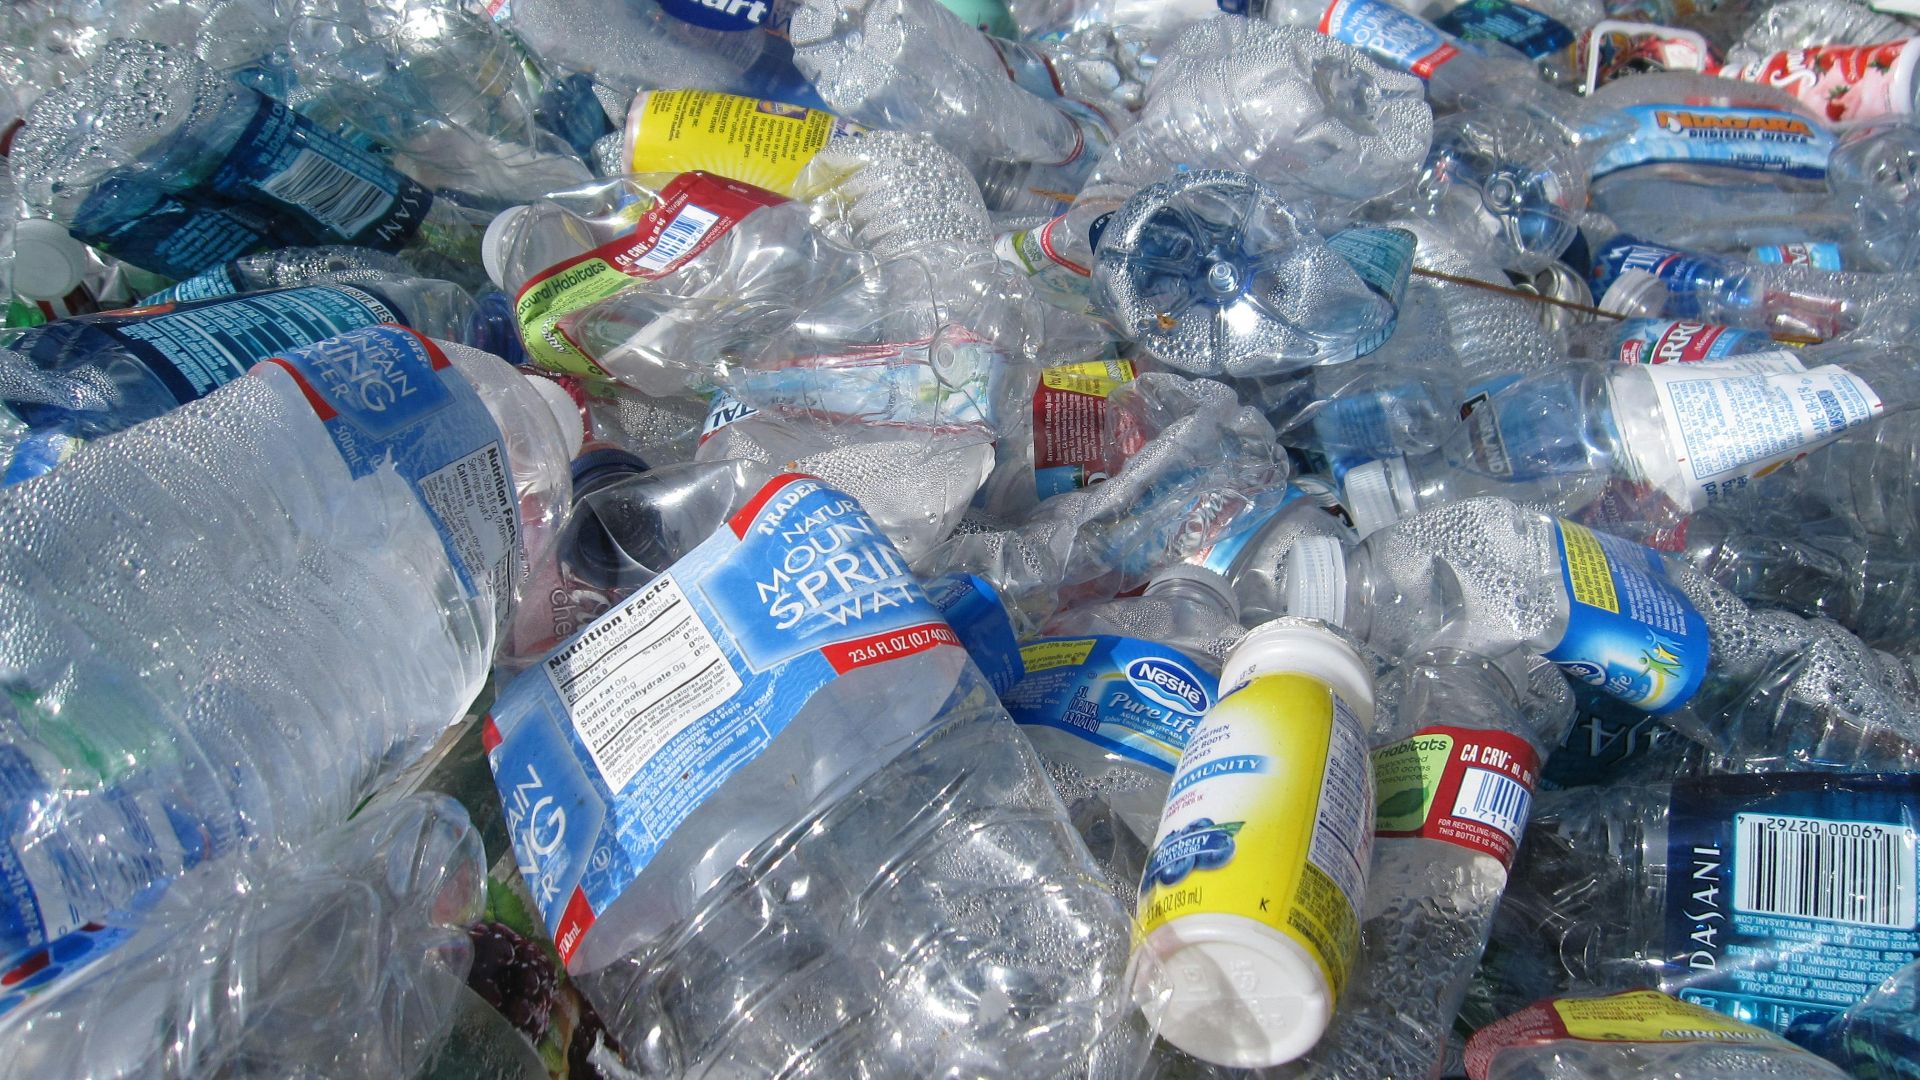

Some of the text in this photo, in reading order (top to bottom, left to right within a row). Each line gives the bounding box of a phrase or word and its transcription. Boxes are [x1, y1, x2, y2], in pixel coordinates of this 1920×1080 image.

[700, 0, 767, 23] art
[1655, 111, 1816, 138] NIAGARA
[377, 178, 422, 242] ASANI
[615, 253, 632, 267] CA
[518, 261, 607, 318] atural Habitats
[296, 349, 350, 399] ATER
[333, 424, 364, 465] 500mL
[455, 461, 473, 500] Calories
[466, 456, 492, 522] Servings about 2
[486, 446, 509, 506] Nutrition
[757, 482, 823, 536] TRADER
[783, 500, 858, 544] NATUR
[756, 516, 875, 604] MOUN
[769, 541, 904, 630] SPRIN
[550, 587, 577, 641] che
[823, 582, 915, 626] WAT
[546, 577, 671, 670] Nutrition Facts
[552, 650, 585, 678] Serving
[584, 638, 602, 653] Size
[600, 634, 608, 642] 8
[617, 621, 628, 632] oz
[626, 595, 664, 625] (240mL)
[555, 592, 677, 684] Servings Per Container about 3
[848, 644, 878, 664] 23.6
[875, 640, 893, 657] FL
[891, 634, 911, 652] OZ
[561, 643, 629, 694] Amount Per Serving
[574, 623, 699, 717] Total Fat 0g 0%
[579, 632, 705, 728] Sodium 0mg 0%
[566, 667, 609, 703] Calories 0
[586, 640, 710, 739] Total Carbohydrate 0g 0%
[673, 679, 699, 698] calories
[1138, 663, 1203, 705] Nestlé
[710, 715, 722, 726] CA
[744, 706, 754, 716] CA
[1111, 692, 1162, 721] Pure
[589, 705, 638, 749] Protein 0g
[636, 735, 656, 754] Daily
[654, 716, 678, 738] Values
[677, 707, 693, 719] are
[692, 692, 716, 711] based
[656, 712, 716, 763] SOLD EXCLUSIVELY
[1120, 711, 1183, 742] AGUA PURIFICADA
[635, 740, 659, 765] calorie
[1201, 733, 1231, 750] BODY'S
[1379, 738, 1447, 760] Habitats
[1459, 743, 1478, 763] CA
[1480, 746, 1512, 771] CRV;
[1459, 806, 1467, 815] 0
[1438, 818, 1512, 849] FOR RECYCLING/REFUN
[1438, 827, 1488, 846] THIS BOTTLE IS
[1737, 815, 1884, 840] 49000 02762 4
[1157, 834, 1211, 862] Blueberry
[1163, 886, 1203, 913] OZ (93 mL)
[1259, 897, 1270, 913] K
[1682, 847, 1726, 971] DASANI
[1735, 915, 1812, 932] WWW.DASANI.COM
[1772, 927, 1828, 943] INFORMATION,
[1814, 922, 1836, 934] VISIT
[1817, 946, 1862, 959] COCA-COLA
[1834, 934, 1850, 946] AND
[1854, 937, 1889, 948] QUALITY
[1891, 940, 1919, 950] WATER
[1806, 954, 1896, 972] COCA-COLA COMPANY,
[1864, 950, 1881, 961] THE
[1757, 972, 1866, 992] ASSOCIATION, ATLANTA, GA
[1776, 963, 1867, 981] UNDER AUTHORITY OF
[1740, 981, 1853, 1001] MEMBER OF THE COCA-COLA
